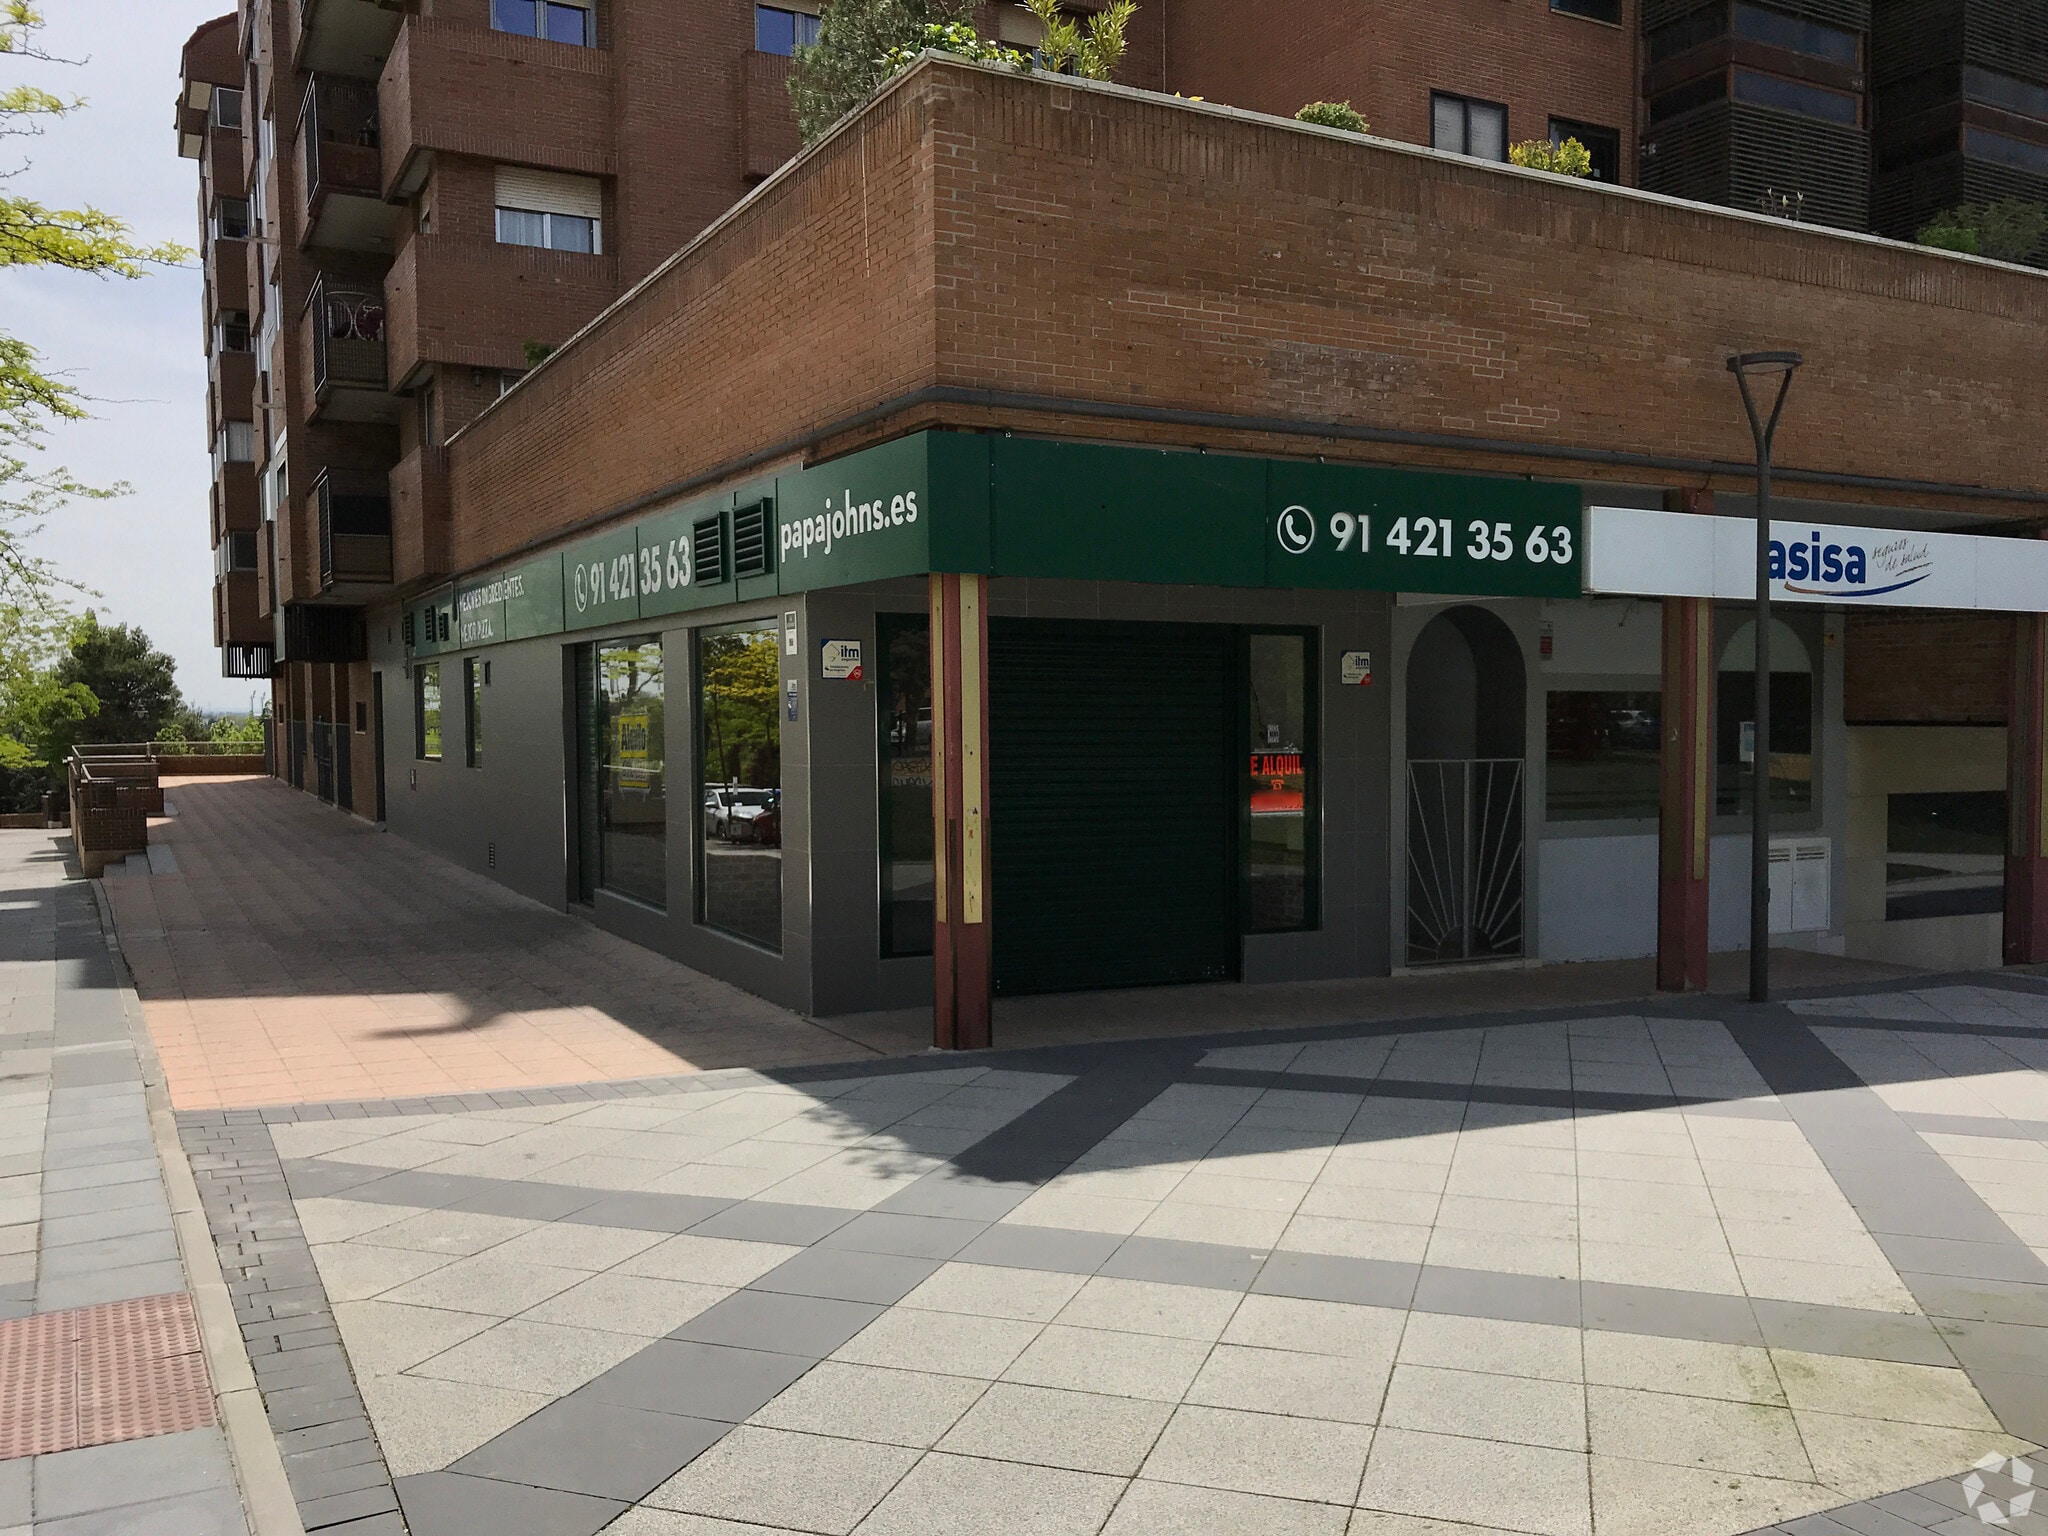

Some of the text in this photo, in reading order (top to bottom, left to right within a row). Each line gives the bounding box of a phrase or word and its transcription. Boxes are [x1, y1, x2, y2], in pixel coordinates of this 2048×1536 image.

[781, 489, 918, 563] papajohns.es
[1329, 511, 1573, 565] 91 421 35 63
[591, 536, 691, 605] 91 421 35 63
[1769, 531, 1866, 584] asisa
[840, 645, 859, 658] itm
[1250, 755, 1303, 777] E ALQUIL
